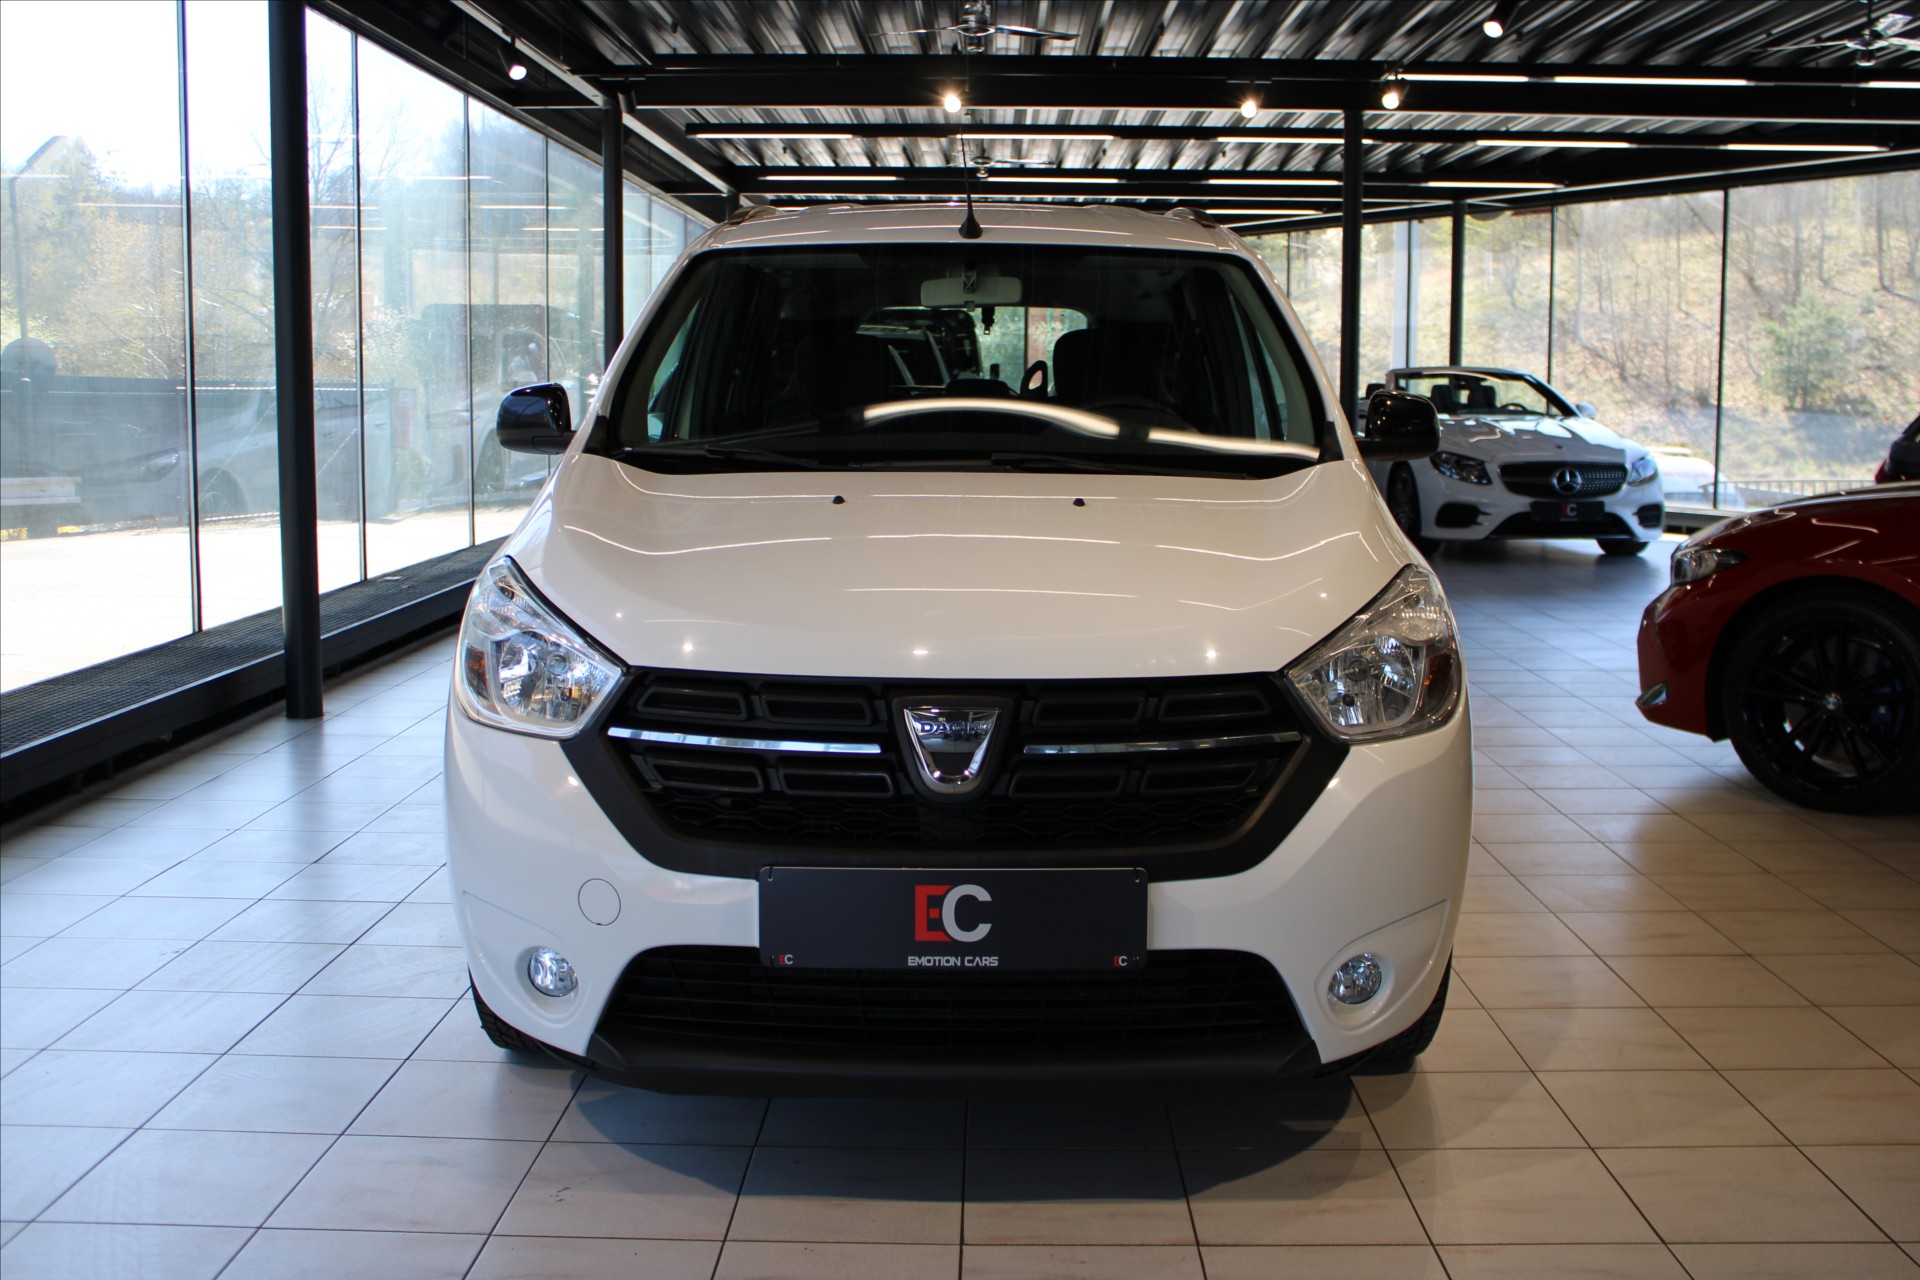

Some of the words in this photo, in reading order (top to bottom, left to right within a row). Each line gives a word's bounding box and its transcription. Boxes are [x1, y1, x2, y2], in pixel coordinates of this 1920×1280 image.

[915, 884, 992, 942] EC
[907, 956, 961, 967] EMOTION
[964, 956, 999, 967] CARS
